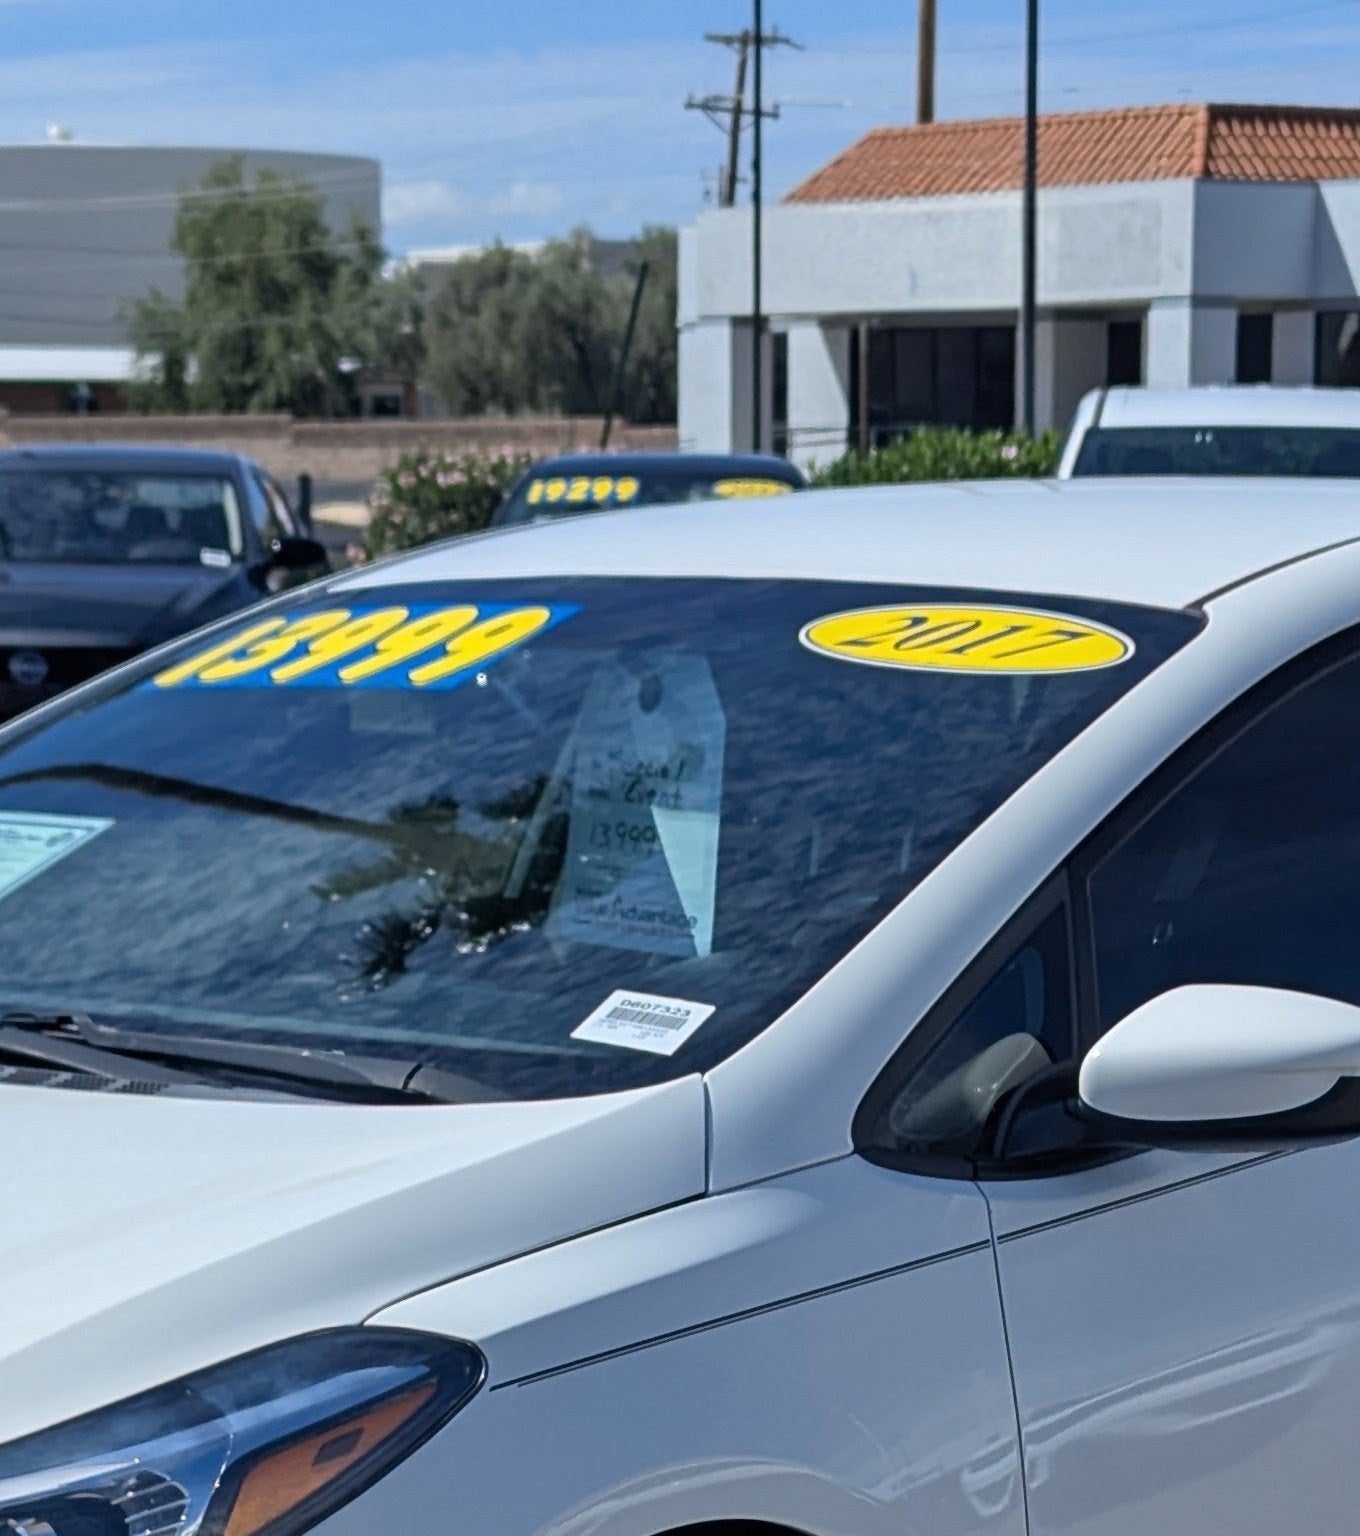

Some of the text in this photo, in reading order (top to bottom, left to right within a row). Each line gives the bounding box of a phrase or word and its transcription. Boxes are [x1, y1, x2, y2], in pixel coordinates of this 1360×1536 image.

[526, 475, 639, 505] 19299
[153, 605, 551, 688] 13999
[834, 616, 1095, 659] 2017
